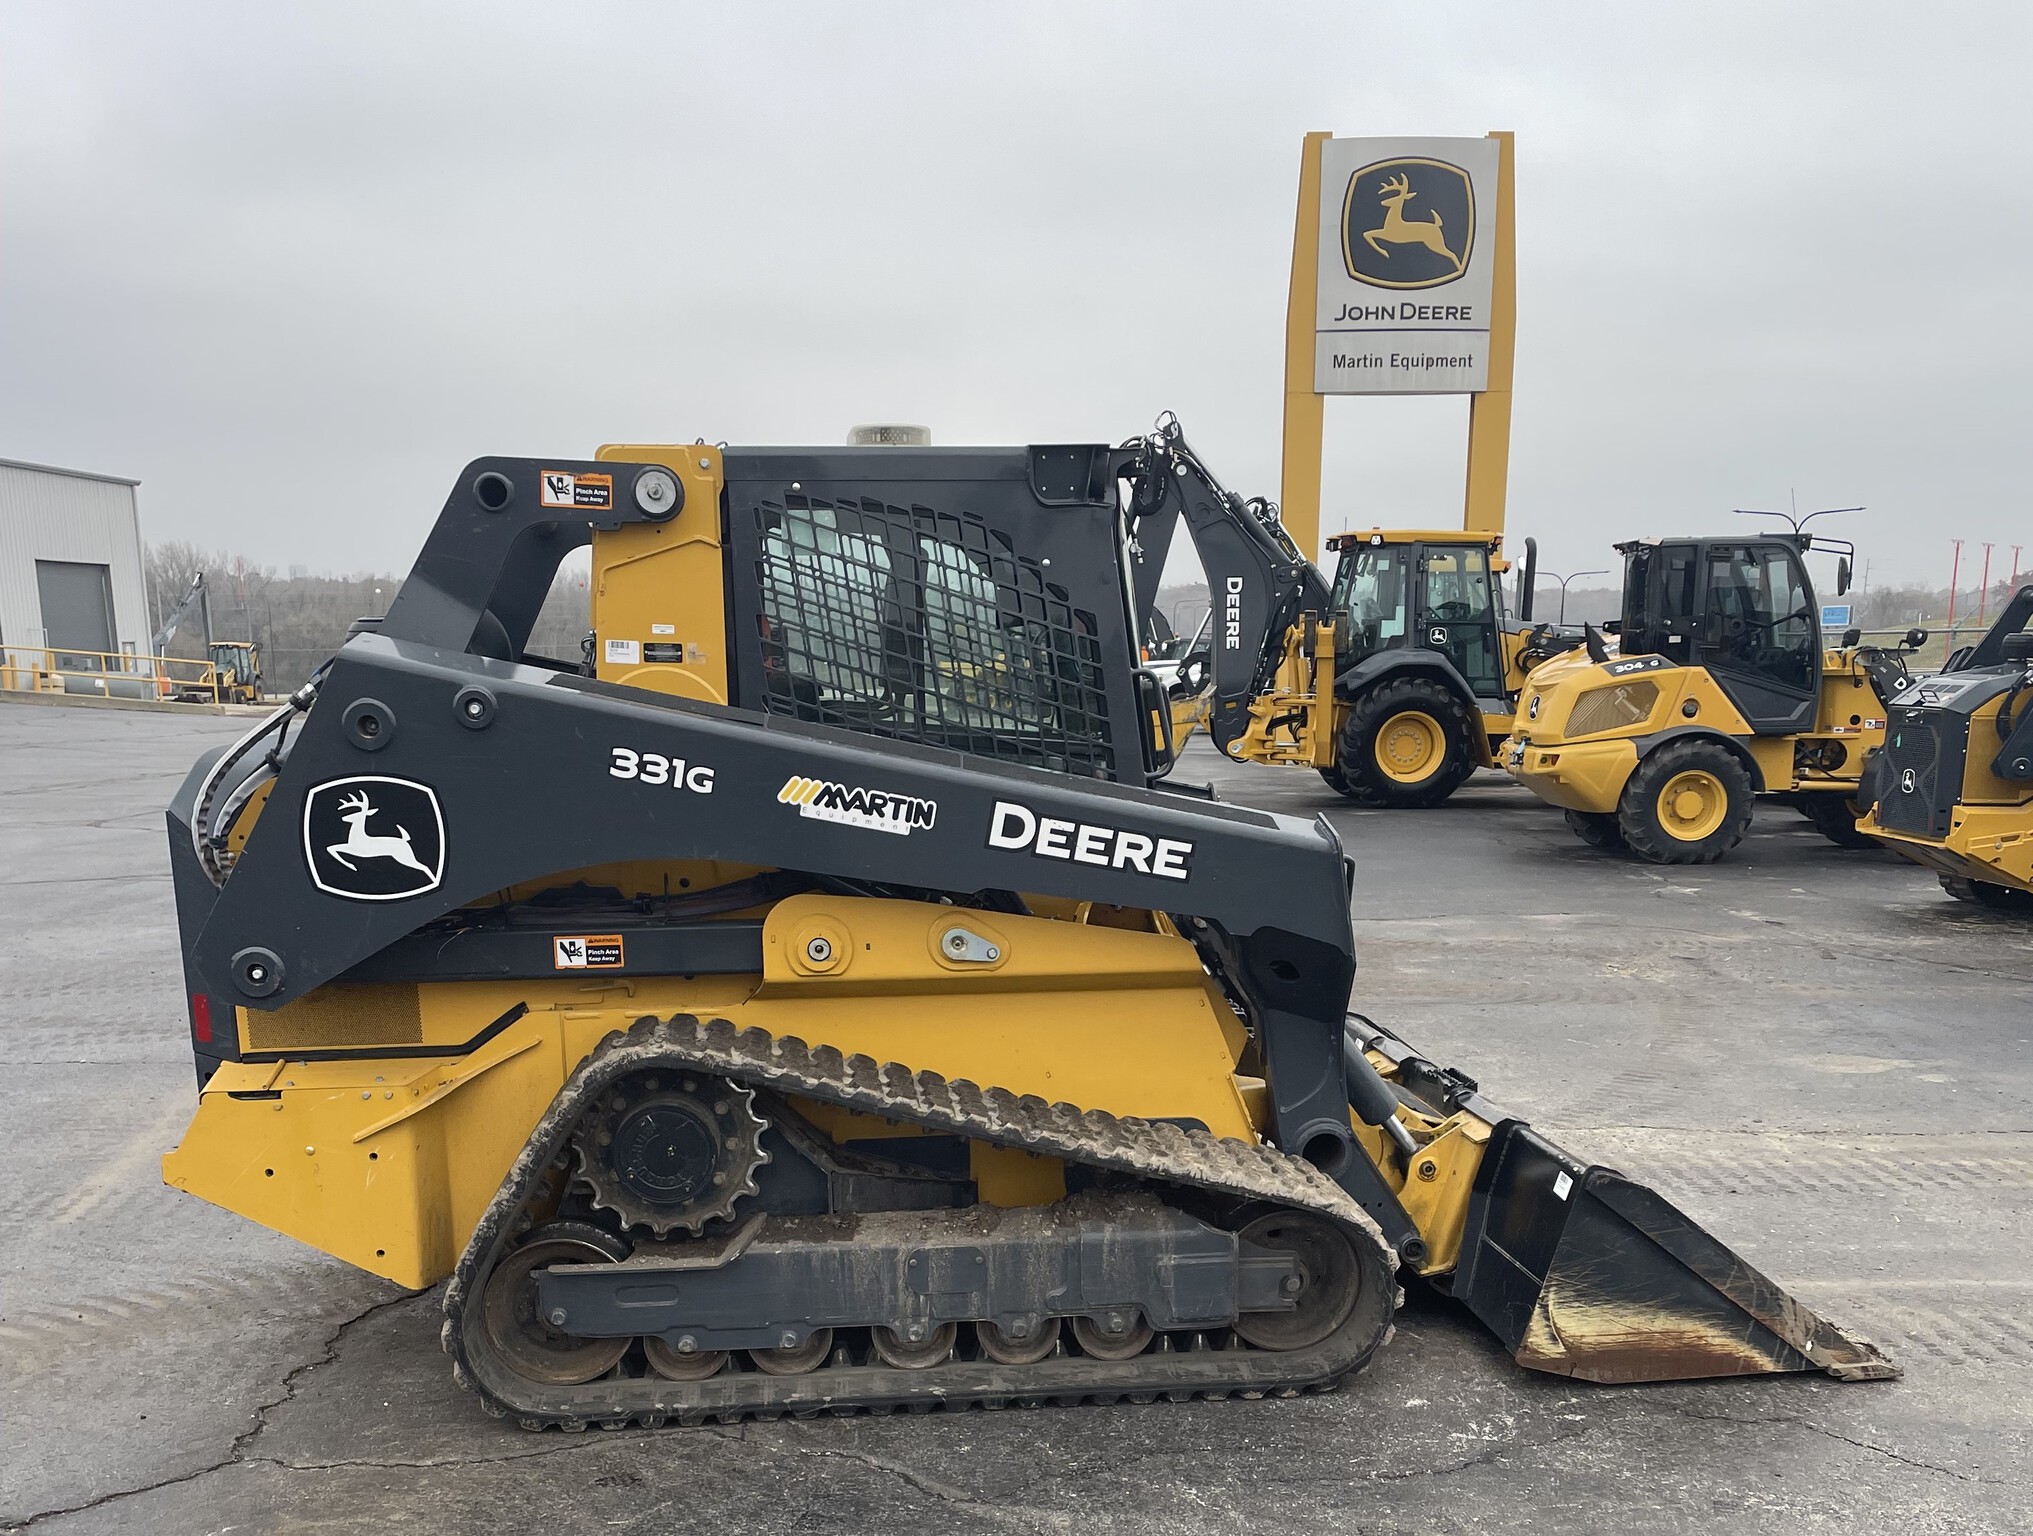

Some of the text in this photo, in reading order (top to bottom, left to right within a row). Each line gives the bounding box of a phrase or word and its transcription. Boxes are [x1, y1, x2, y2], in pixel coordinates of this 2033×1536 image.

[1334, 302, 1472, 321] JOHN DEERE
[1333, 353, 1473, 371] Martin Equipment
[575, 487, 608, 496] Pinch Area
[1226, 577, 1243, 650] DEERE
[1614, 661, 1645, 673] 304
[609, 747, 715, 794] 331G
[812, 783, 935, 827] MARTIN
[801, 806, 909, 832] Equipment
[988, 800, 1193, 880] DEERE
